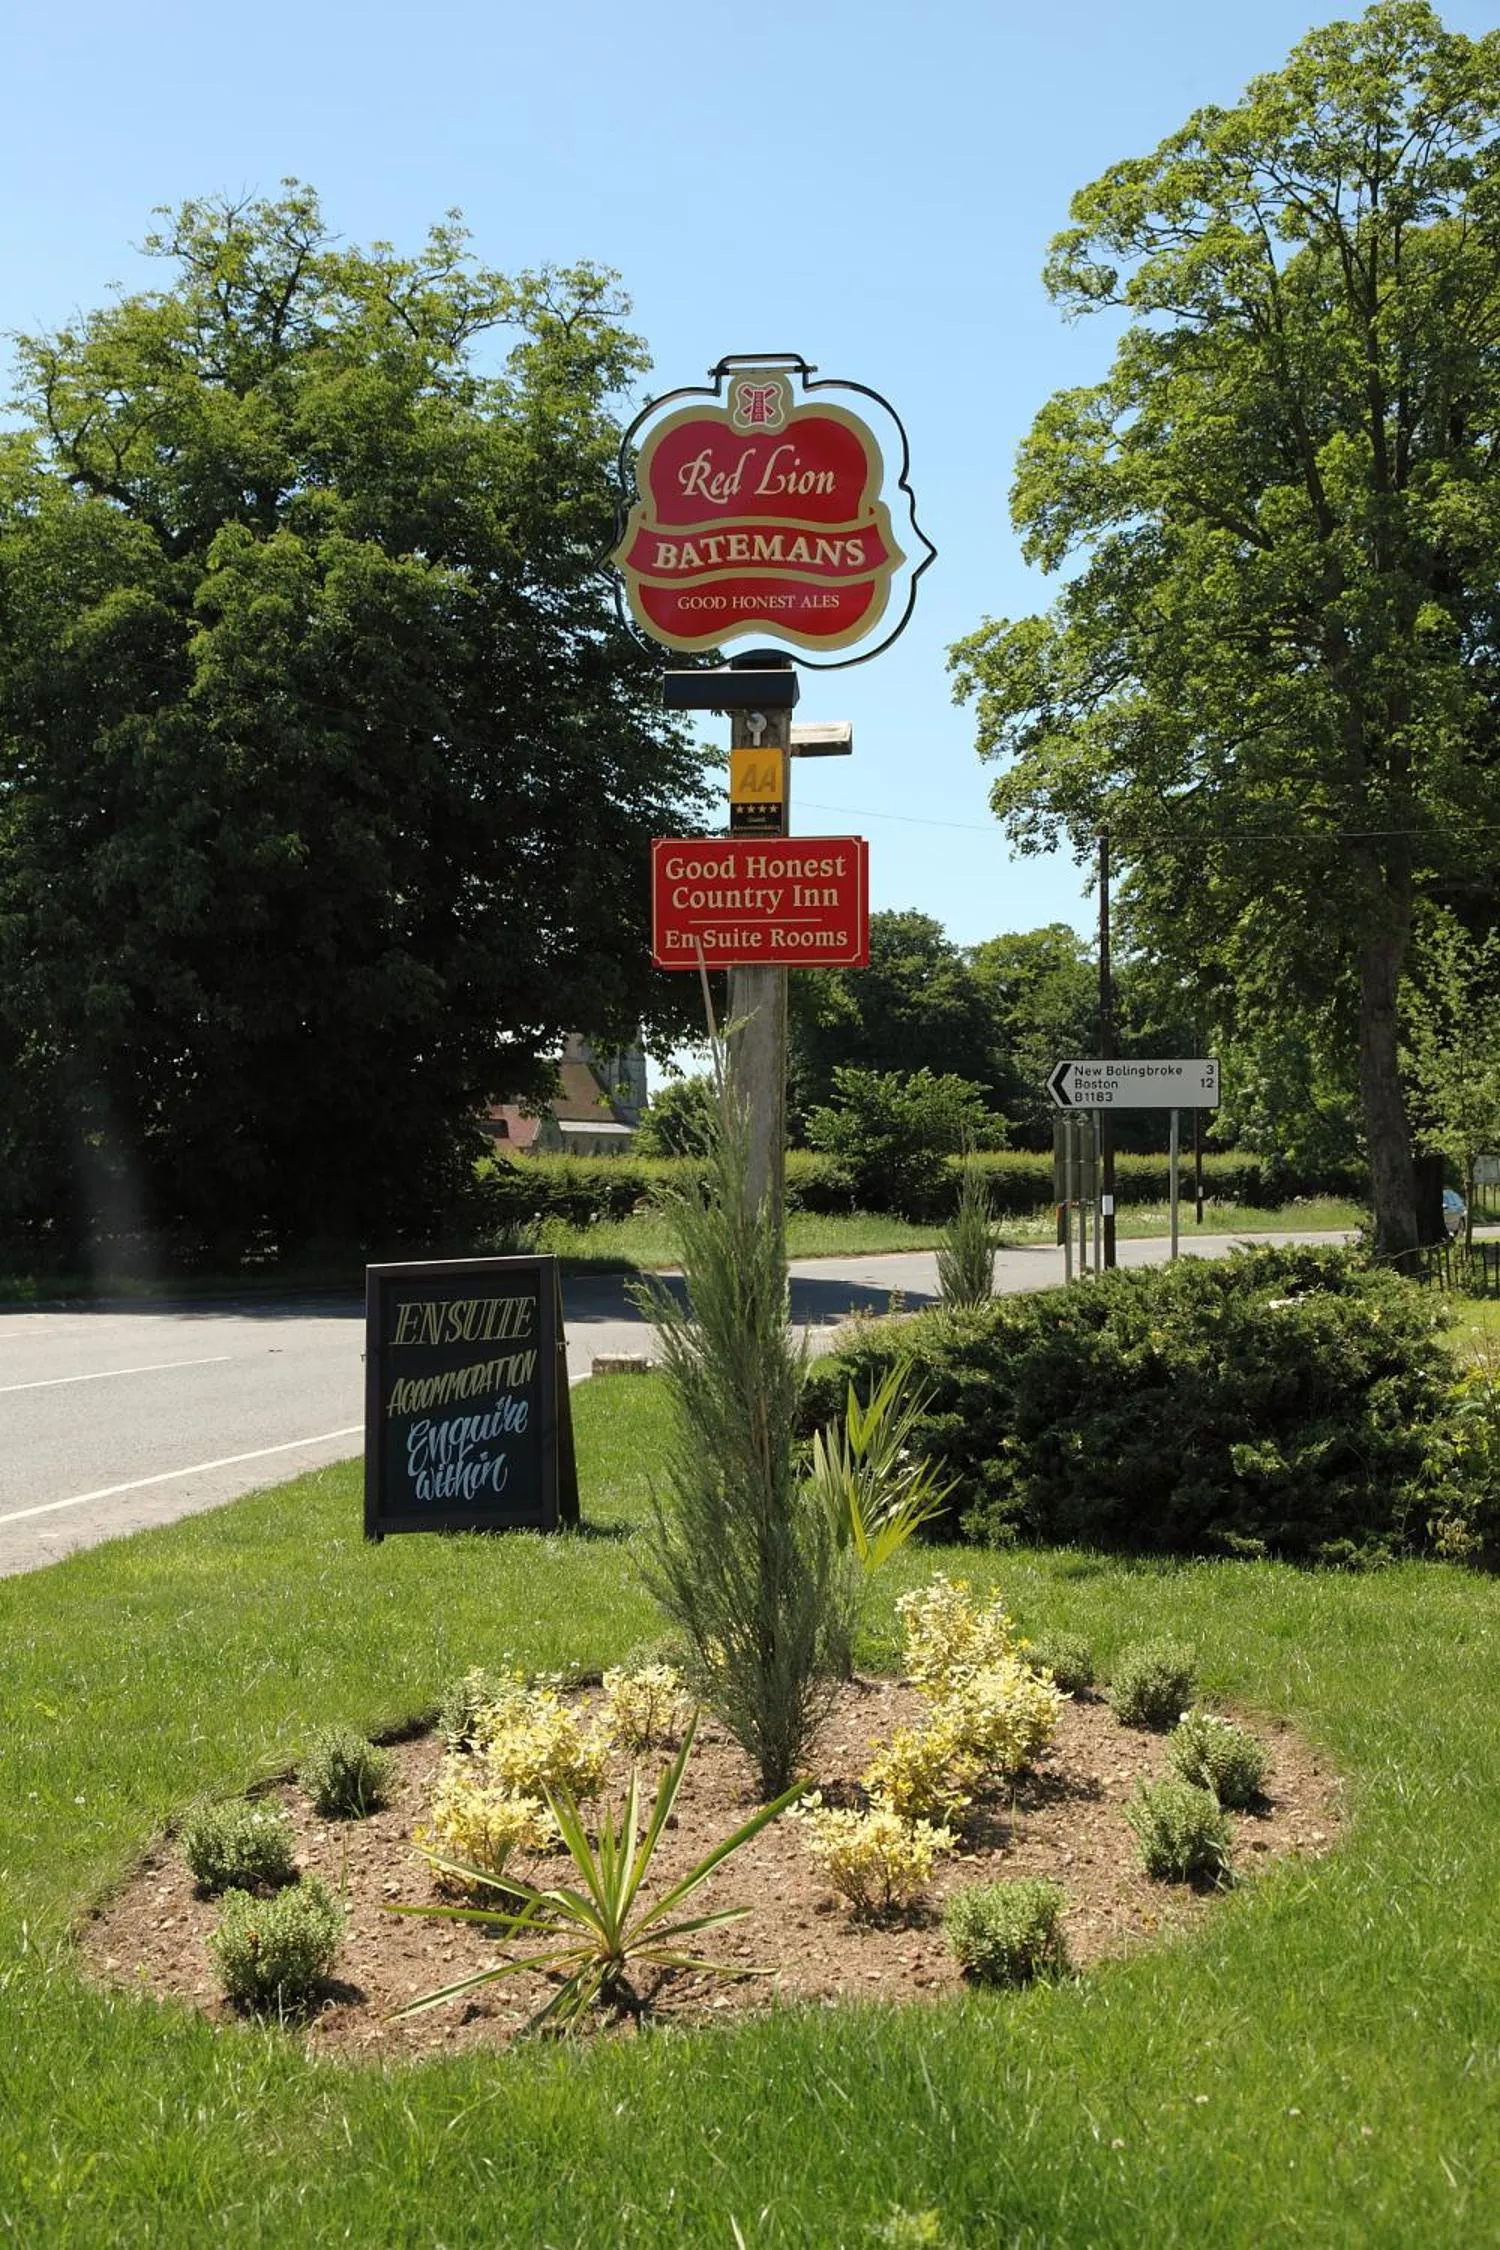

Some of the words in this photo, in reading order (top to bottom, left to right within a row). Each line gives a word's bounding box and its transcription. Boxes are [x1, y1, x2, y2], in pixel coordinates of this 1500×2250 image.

[678, 448, 756, 504] Red
[756, 444, 836, 495] Lion
[652, 534, 866, 570] BATEMANS
[677, 596, 727, 610] GOOD
[732, 595, 796, 609] HONEST
[800, 594, 840, 608] ALES
[739, 764, 777, 793] AA
[665, 855, 736, 880] Good
[746, 855, 847, 879] Honest
[672, 887, 784, 914] Country
[793, 884, 839, 907] Inn
[665, 930, 701, 949] En
[703, 928, 762, 949] Suite
[770, 927, 848, 947] Rooms
[1074, 1065, 1102, 1077] New
[1106, 1064, 1183, 1078] Bolingbroke
[1206, 1065, 1214, 1075] 3
[1074, 1079, 1119, 1090] Boston
[1200, 1078, 1214, 1089] 12
[1074, 1092, 1113, 1102] B1183
[388, 1297, 537, 1345] ENSUITE
[407, 1395, 529, 1477] Enquire
[415, 1450, 508, 1500] within
